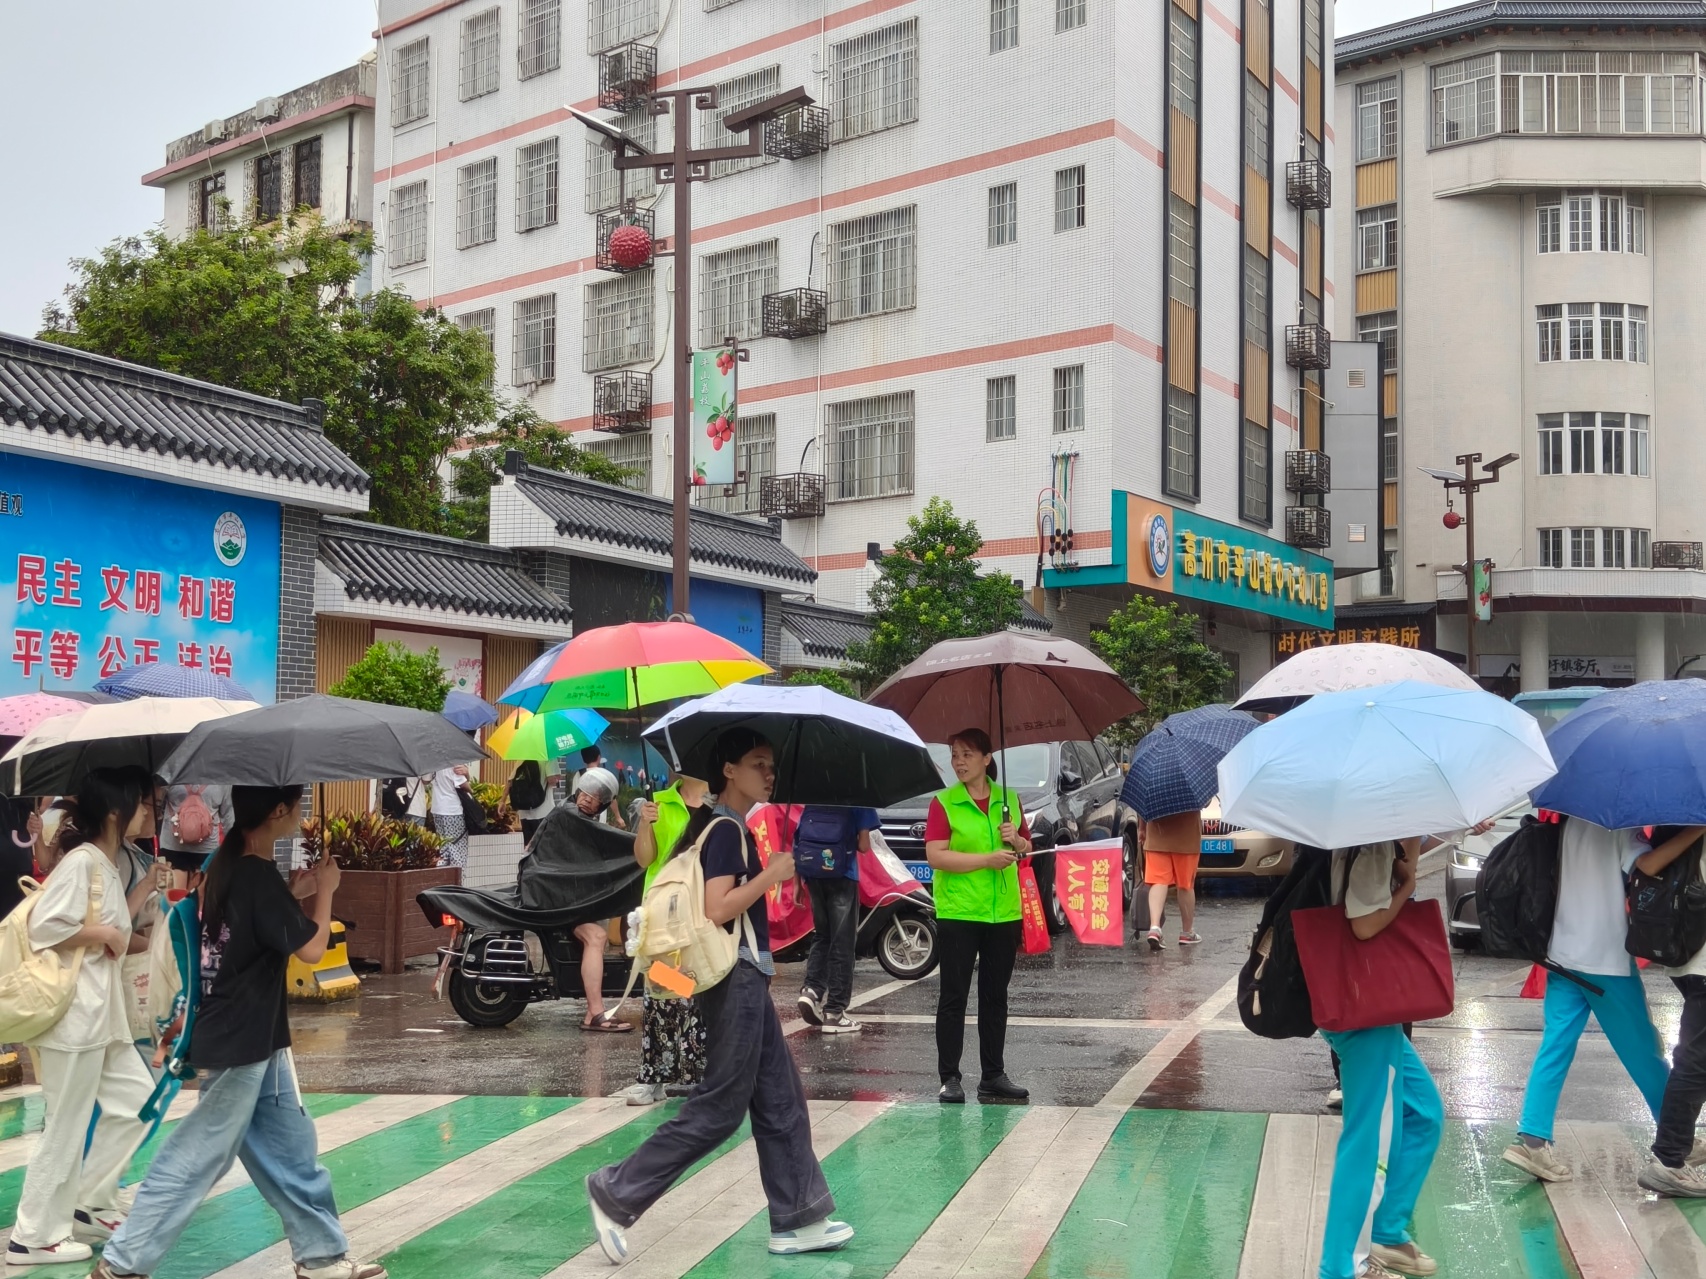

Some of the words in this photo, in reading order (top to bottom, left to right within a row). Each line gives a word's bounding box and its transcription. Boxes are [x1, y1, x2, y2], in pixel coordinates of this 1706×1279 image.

[699, 357, 711, 407] 平山荔枝
[17, 553, 82, 607] 民主
[100, 564, 162, 616] 文明
[178, 575, 236, 623] 和谐
[12, 628, 79, 679] 平等
[1067, 859, 1086, 918] 人人有
[1091, 858, 1110, 931] 交通安全
